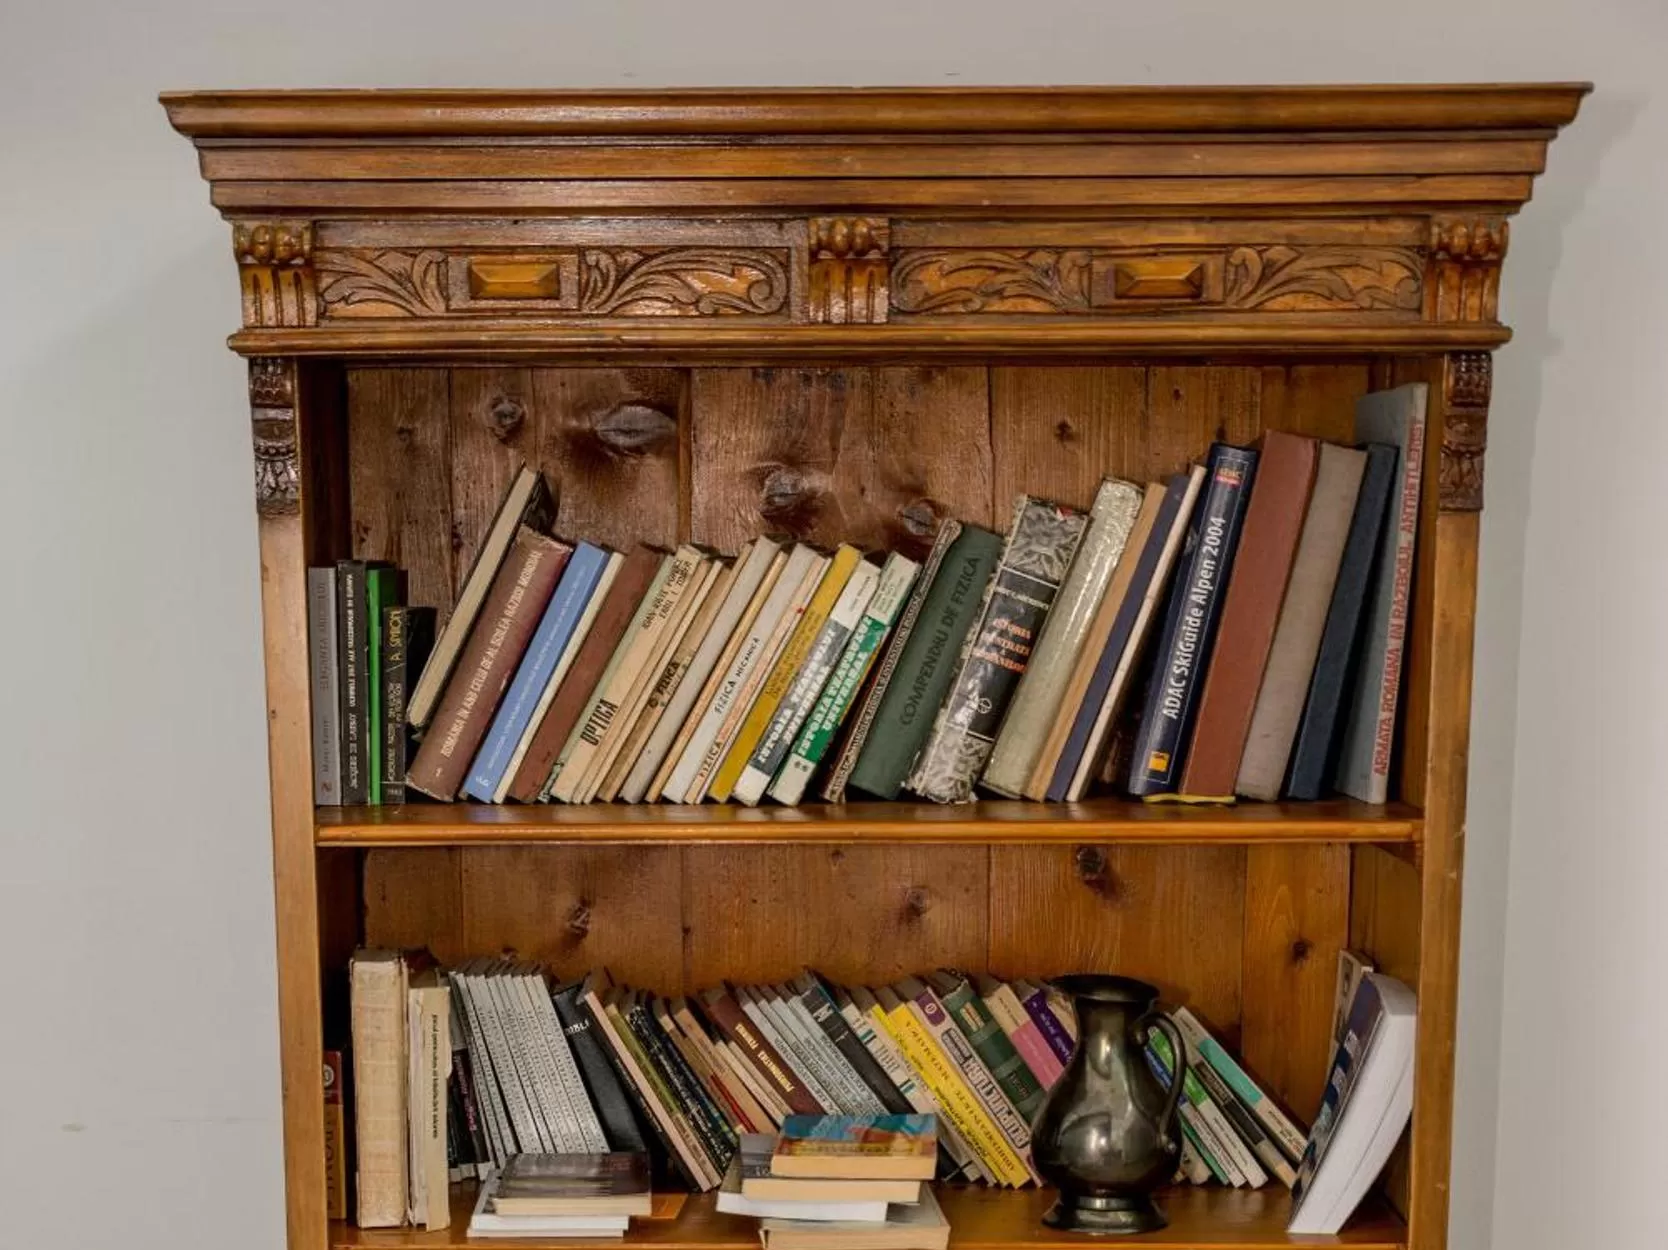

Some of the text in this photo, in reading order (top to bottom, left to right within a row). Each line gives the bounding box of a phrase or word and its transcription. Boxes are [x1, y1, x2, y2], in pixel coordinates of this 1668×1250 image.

[388, 610, 402, 646] SIMON
[896, 553, 982, 727] COMPENDIU DE FIZICA
[1161, 515, 1226, 719] ADAC SkiGuide Alpen 2004
[654, 659, 680, 696] FIZICA
[712, 678, 737, 715] FIZICA
[1370, 716, 1392, 776] ARMATA
[1388, 622, 1403, 640] IN
[578, 696, 619, 747] OPTICA
[756, 706, 793, 763] ISTORIA
[697, 739, 722, 778] FIZICA
